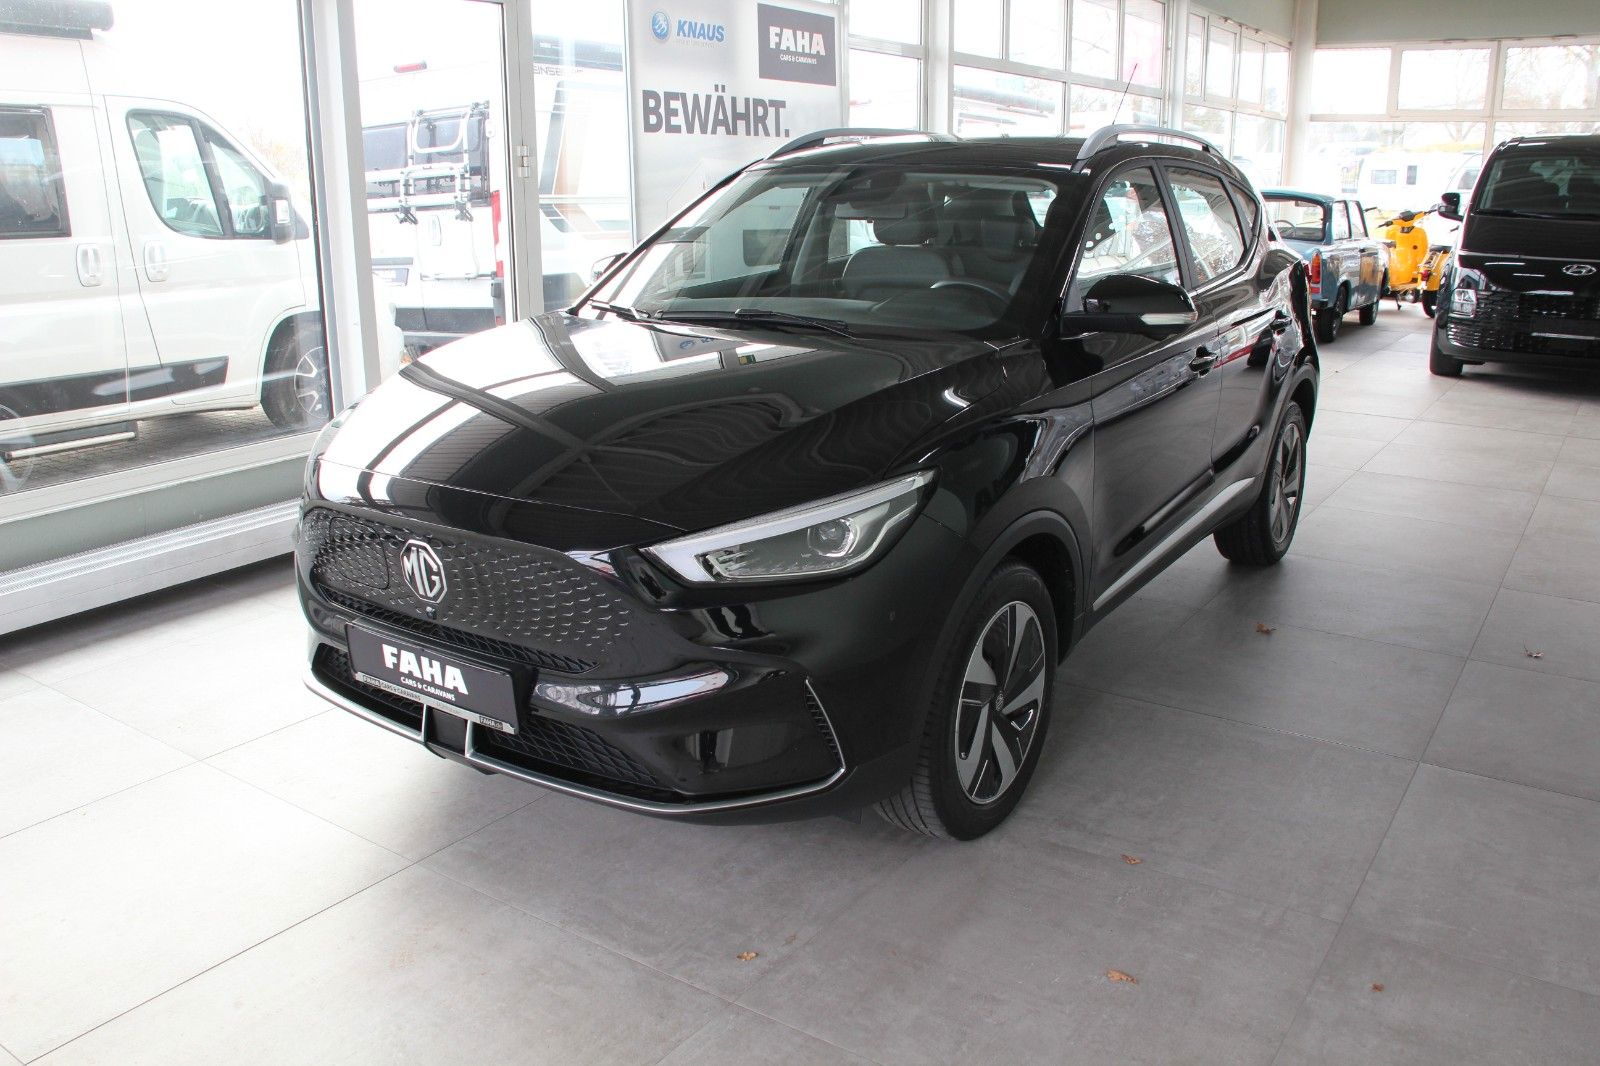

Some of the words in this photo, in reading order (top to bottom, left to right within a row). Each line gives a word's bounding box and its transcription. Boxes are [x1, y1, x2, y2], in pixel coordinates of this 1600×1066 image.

[676, 19, 725, 43] KNAUS
[769, 26, 826, 56] FAHA
[780, 54, 791, 62] CARS
[642, 84, 790, 138] BEWÄHRT.
[403, 546, 442, 598] MG
[382, 643, 469, 695] FAHA
[401, 676, 418, 688] CARS
[423, 684, 456, 702] CARAVANS
